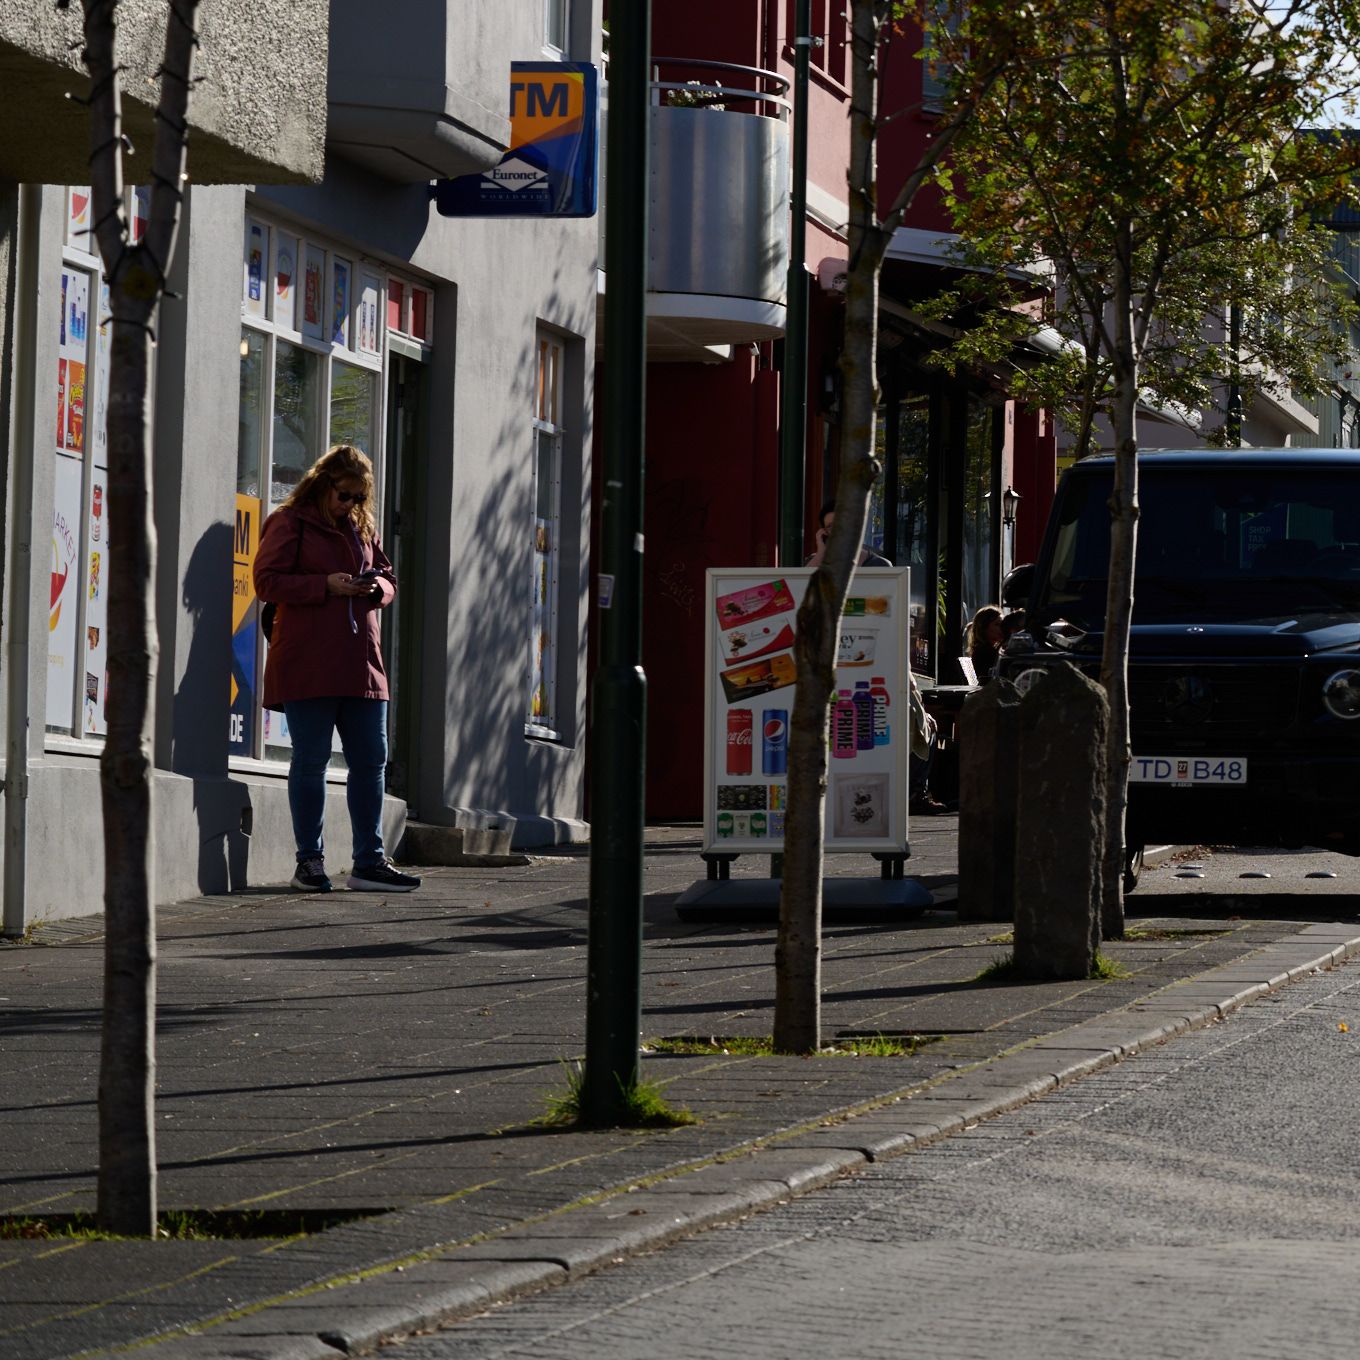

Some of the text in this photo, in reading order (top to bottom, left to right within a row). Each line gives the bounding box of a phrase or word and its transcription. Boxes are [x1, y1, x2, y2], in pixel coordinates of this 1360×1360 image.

[492, 168, 538, 181] Euronet
[837, 709, 854, 752] PRIME
[873, 696, 887, 738] PRIME
[1137, 759, 1172, 779] TD
[1193, 760, 1242, 780] B48
